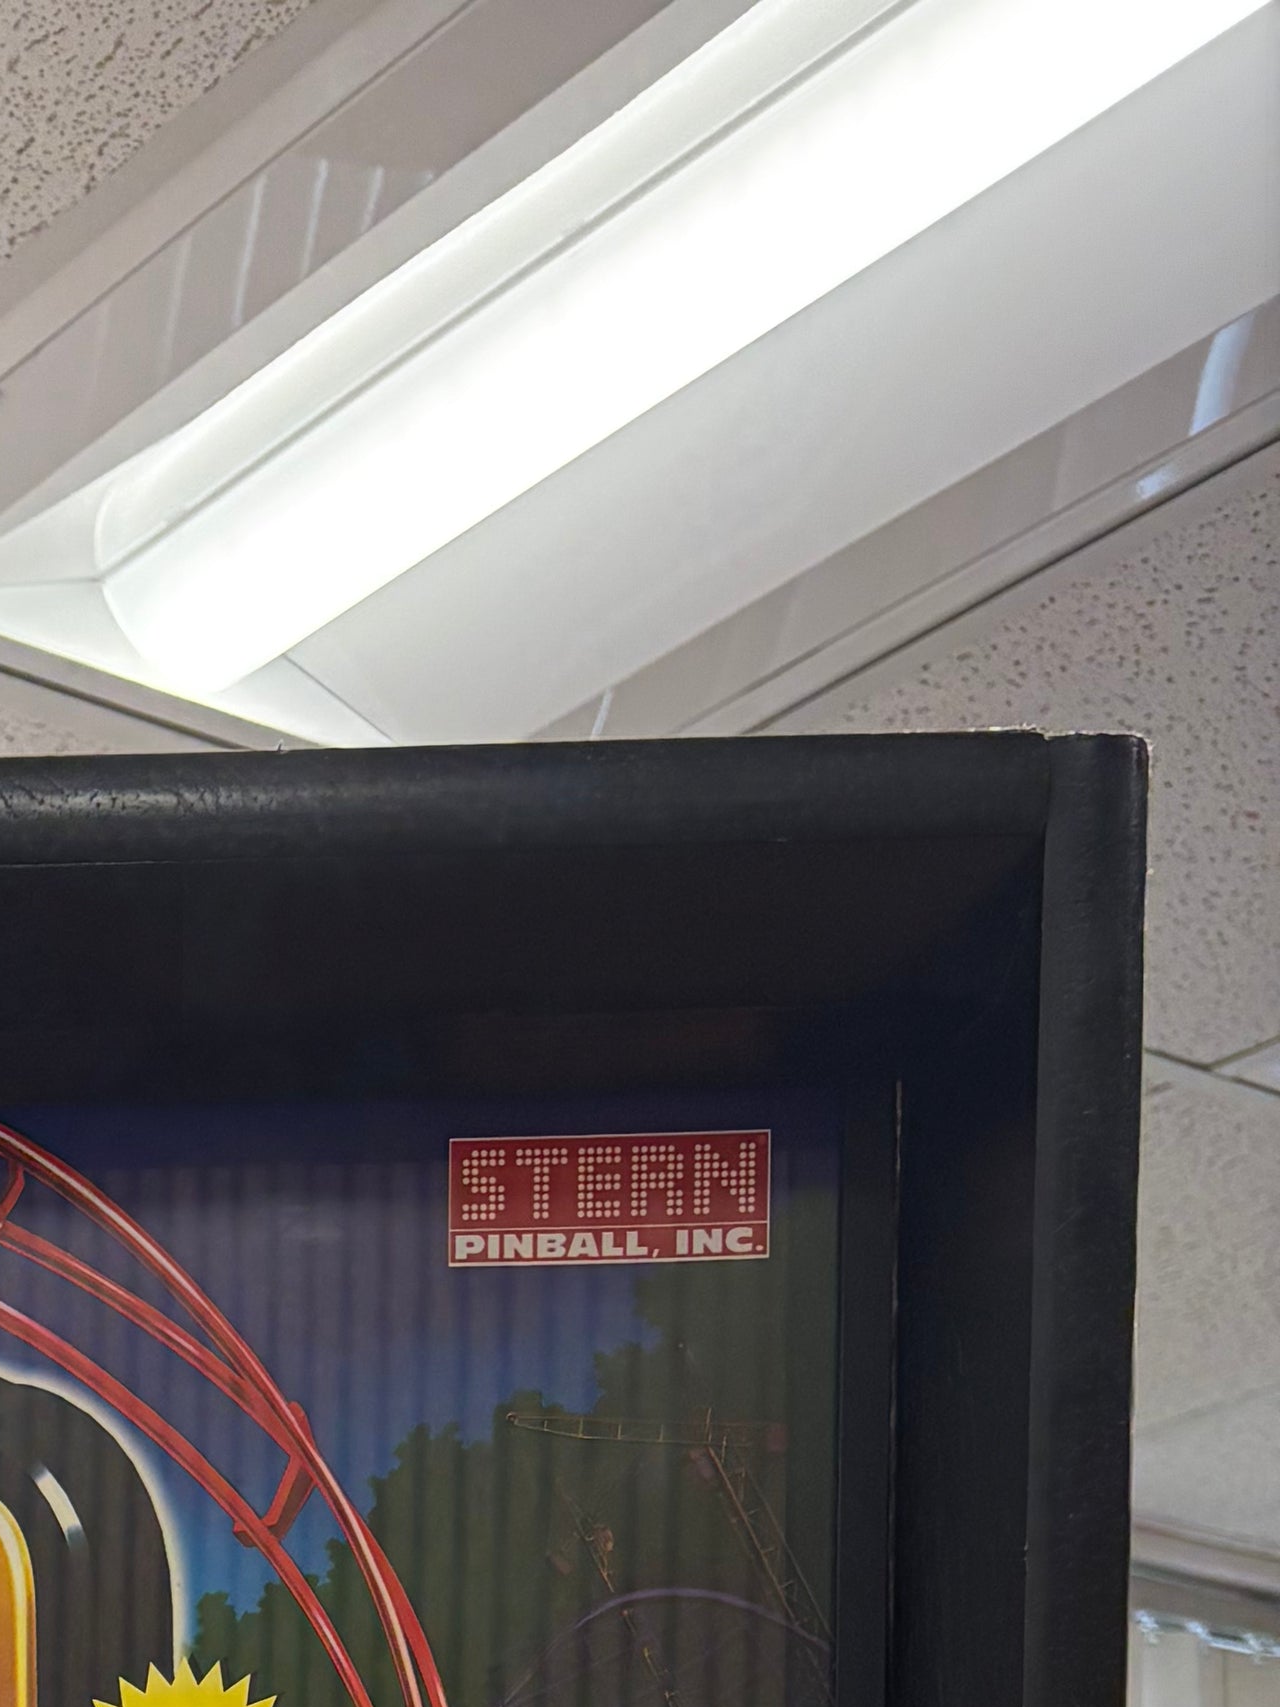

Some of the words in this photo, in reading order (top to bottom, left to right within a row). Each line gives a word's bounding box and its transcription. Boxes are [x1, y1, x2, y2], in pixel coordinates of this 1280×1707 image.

[461, 1141, 758, 1222] STERN
[454, 1230, 660, 1260] PINBALL,
[675, 1226, 764, 1256] INC.
